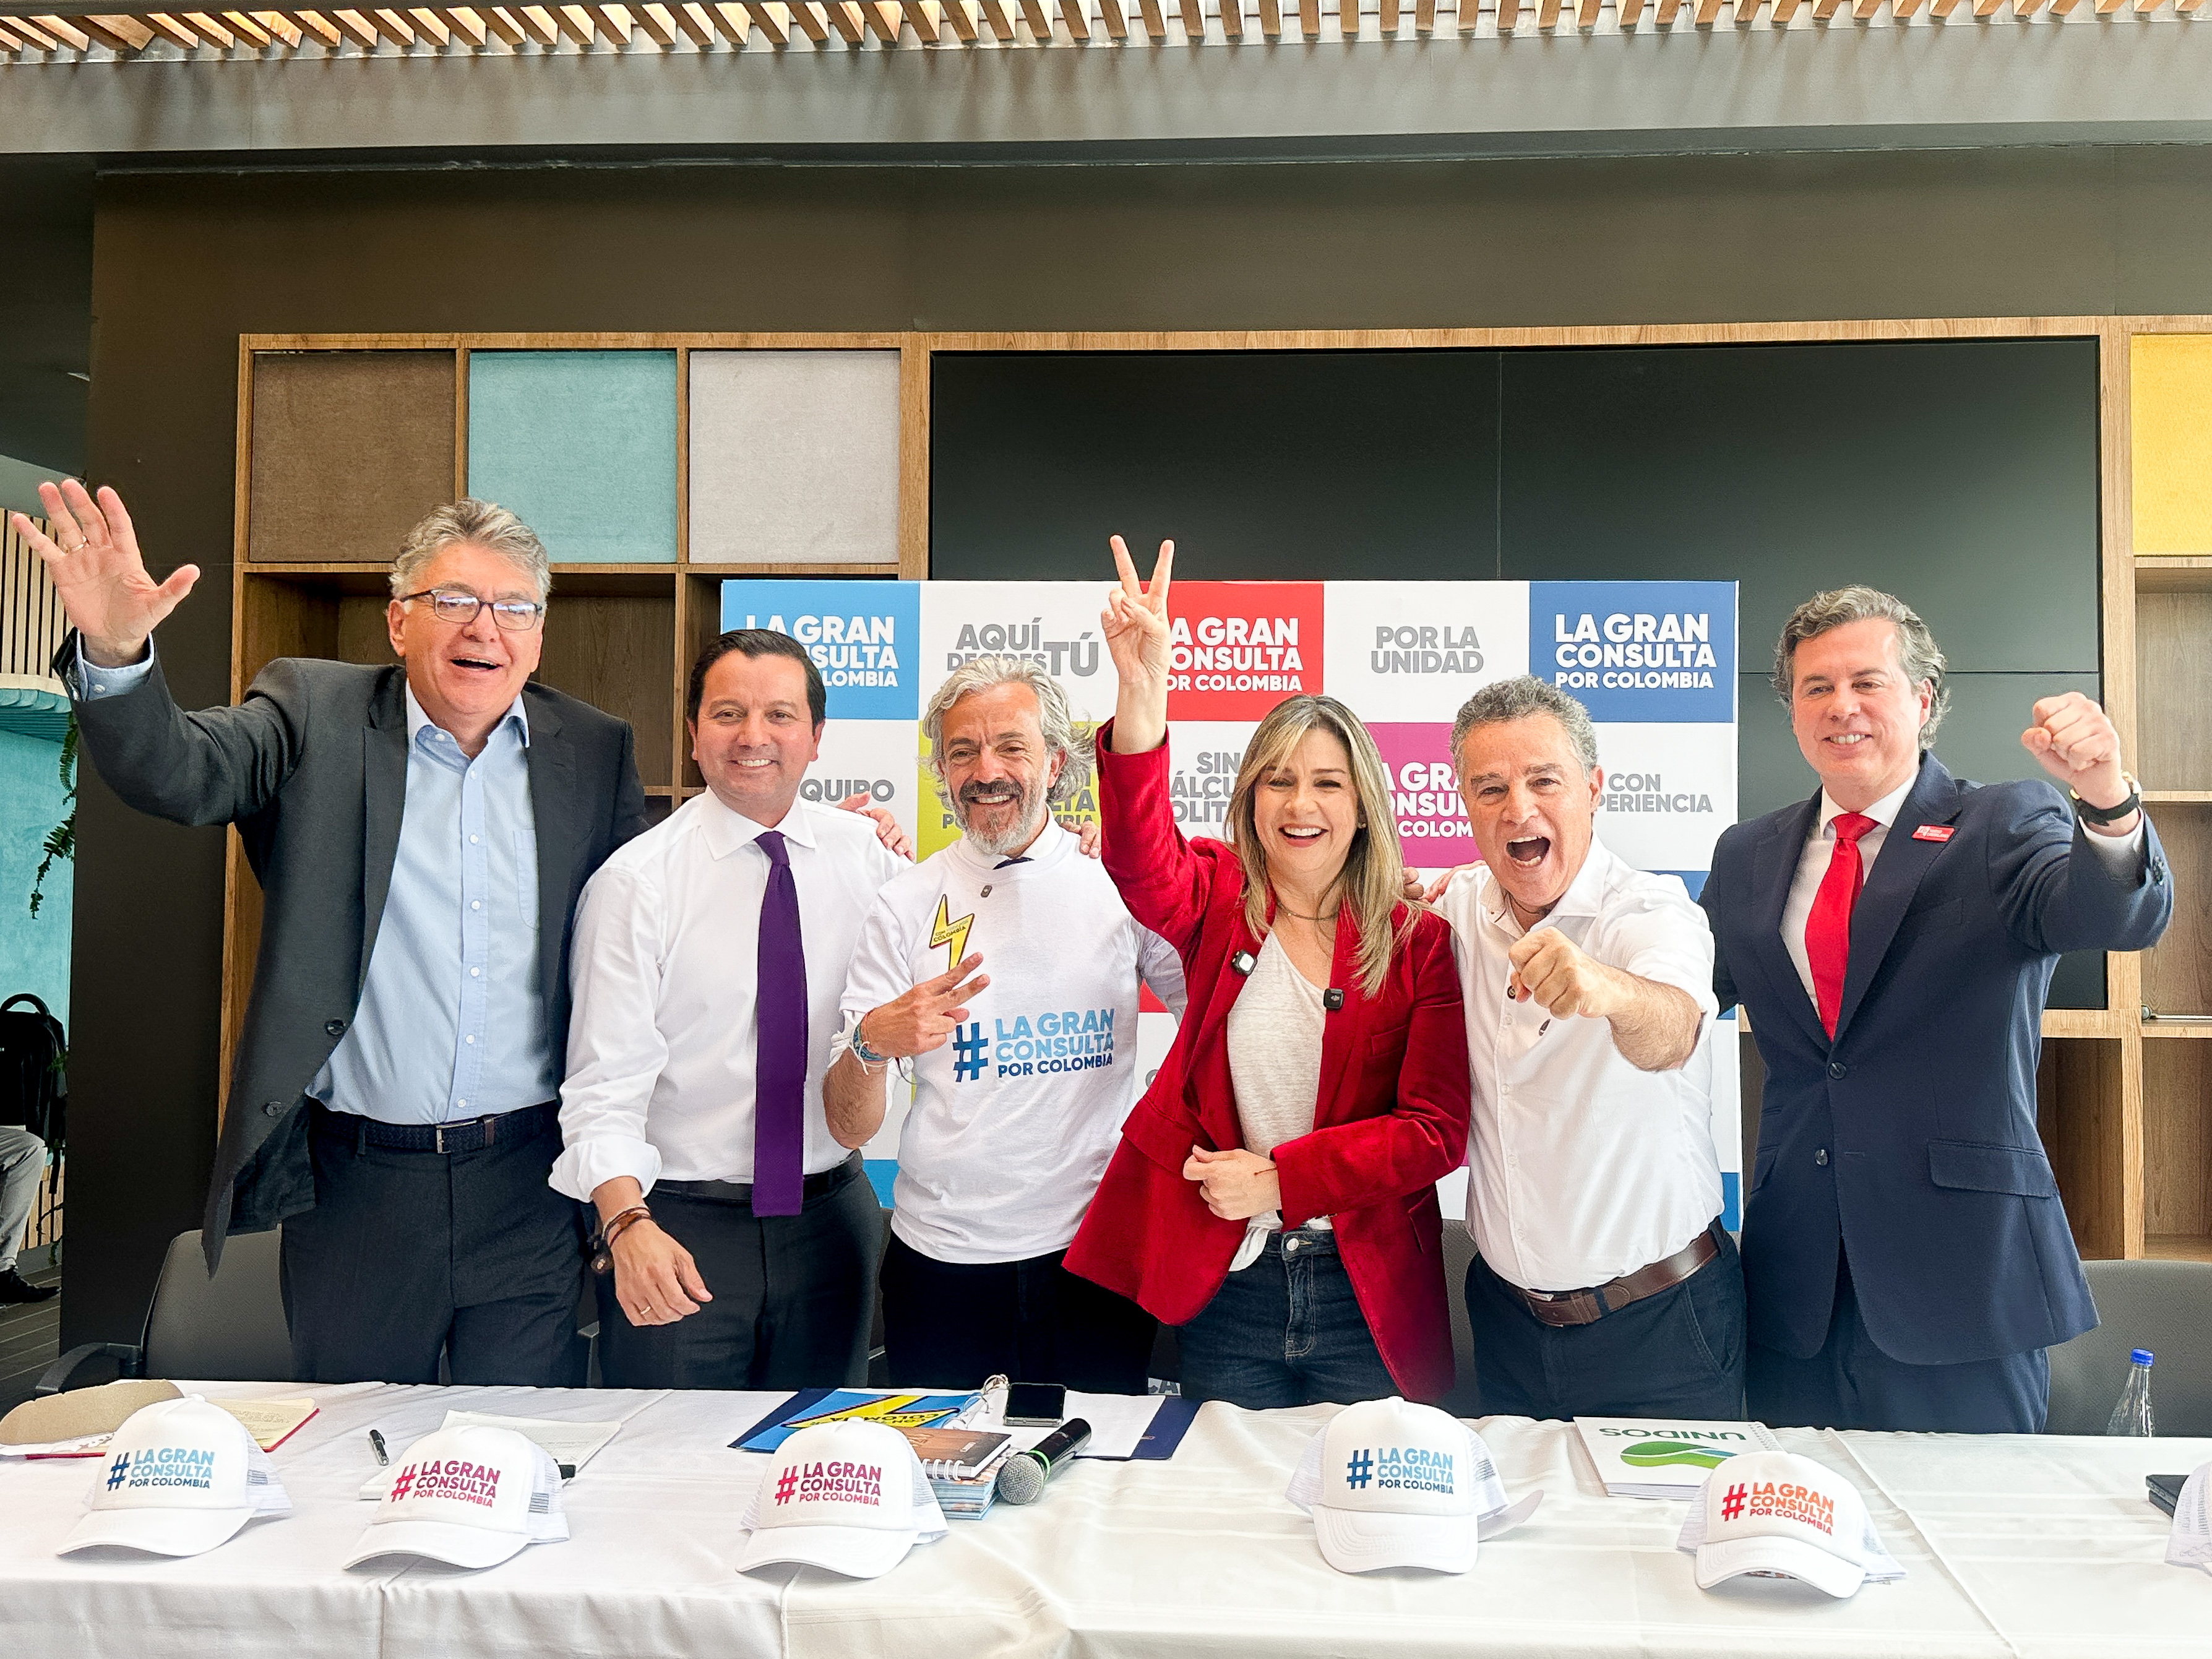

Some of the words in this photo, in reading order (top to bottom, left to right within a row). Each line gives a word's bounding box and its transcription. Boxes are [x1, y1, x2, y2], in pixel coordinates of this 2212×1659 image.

[793, 614, 895, 644] GRAN
[955, 617, 1043, 651] AQUÍ
[1170, 617, 1194, 646] A
[1197, 616, 1299, 646] GRAN
[1376, 626, 1437, 649] POR
[1444, 626, 1480, 649] LA
[1555, 614, 1599, 643] LA
[1603, 613, 1710, 643] GRAN
[1043, 632, 1099, 677] TÚ
[1171, 646, 1304, 671] ONSULTA
[1371, 650, 1484, 673] UNIDAD
[1555, 643, 1717, 669] CONSULTA
[822, 670, 898, 687] LOMBIA
[1167, 674, 1191, 691] OR
[1194, 674, 1302, 692] COLOMBIA
[1555, 672, 1598, 688] POR
[1603, 672, 1714, 689] COLOMBIA
[1196, 752, 1241, 774] SIN
[799, 778, 895, 803] QUIPO
[1608, 773, 1661, 791] CON
[1398, 820, 1474, 838] COLOM
[995, 1015, 1033, 1041] LA
[1037, 1008, 1115, 1037] GRAN
[995, 1032, 1114, 1062] CONSULTA
[998, 1062, 1033, 1078] POR
[1038, 1053, 1113, 1074] COLOMBIA
[1599, 1428, 1747, 1441] UNIDOS
[134, 1449, 155, 1465] LA
[158, 1448, 215, 1466] GRAN
[1378, 1447, 1401, 1464] LA
[1404, 1448, 1453, 1470] GRAN
[131, 1464, 212, 1479] CONSULTA
[421, 1460, 441, 1476] LA
[444, 1460, 501, 1484] GRAN
[804, 1462, 824, 1478] LA
[827, 1461, 882, 1482] GRAN
[1377, 1464, 1453, 1485] CONSULTA
[129, 1478, 149, 1488] POR
[152, 1478, 210, 1489] COLOMBIA
[416, 1476, 496, 1499] CONSULTA
[801, 1478, 880, 1496] CONSULTA
[1378, 1480, 1401, 1489] POR
[1403, 1480, 1453, 1495] COLOMBIA
[413, 1489, 434, 1499] POR
[436, 1489, 493, 1508] COLOMBIA
[799, 1493, 820, 1502] POR
[822, 1492, 880, 1506] COLOMBIA
[1752, 1482, 1776, 1496] LA
[1778, 1483, 1834, 1513] GRAN
[1749, 1508, 1773, 1517] POR
[1775, 1509, 1833, 1536] COLOMBIA
[1750, 1496, 1833, 1527] CONSULTA
